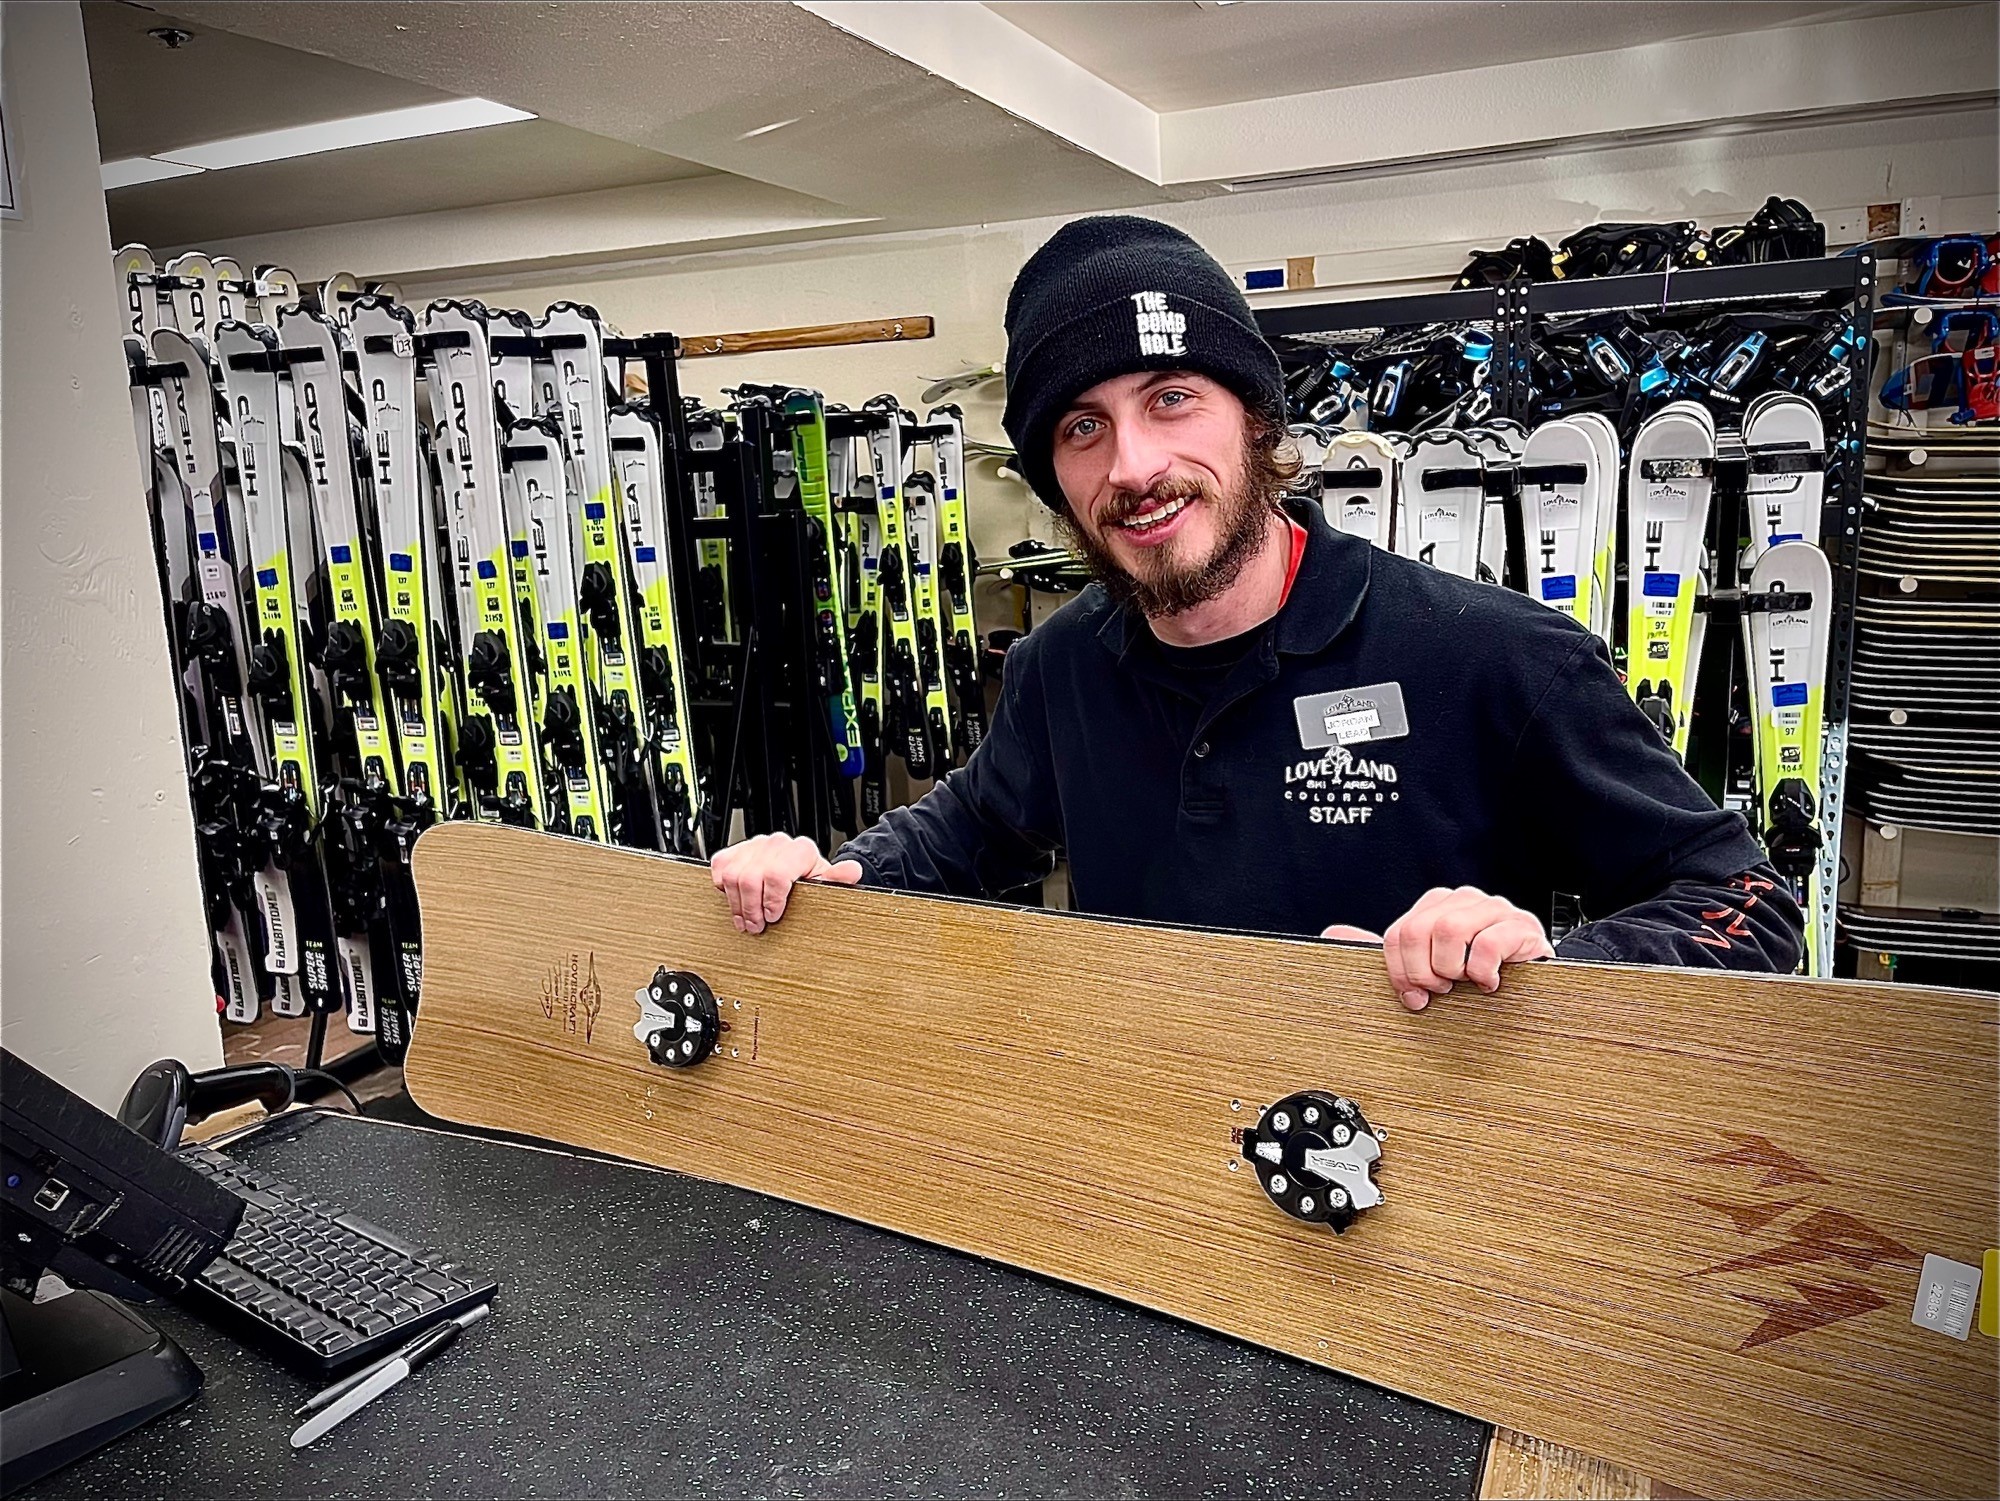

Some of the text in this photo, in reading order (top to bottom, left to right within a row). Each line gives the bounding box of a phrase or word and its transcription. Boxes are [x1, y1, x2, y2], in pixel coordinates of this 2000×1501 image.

[1130, 290, 1168, 313] THE
[1136, 311, 1187, 334] BOMB
[1139, 333, 1188, 356] HOLE
[563, 360, 585, 456] HED
[237, 395, 258, 497] HED
[303, 381, 328, 486] HEAD
[372, 378, 392, 486] HED
[451, 382, 476, 489] HEAD
[623, 463, 644, 547] HEA
[526, 478, 549, 576] HED
[1644, 521, 1663, 572] HE
[1655, 621, 1666, 630] 97
[1325, 700, 1376, 714] LOVELAND
[1338, 727, 1369, 740] LEAD
[1785, 727, 1796, 736] 97
[1285, 758, 1398, 784] LOVELAND
[1306, 779, 1377, 790] SKI AREA
[1284, 791, 1400, 803] COLORADO
[1309, 805, 1373, 824] STAFF
[306, 940, 323, 948] TEAM
[305, 951, 318, 990] SUPER
[315, 952, 328, 991] SHAPE
[402, 953, 417, 992] SUPER
[569, 954, 579, 1035] HOVERCRAFT
[381, 1006, 393, 1043] SUPER
[389, 1008, 402, 1046] SHAPE
[1925, 1282, 1944, 1321] 22336
